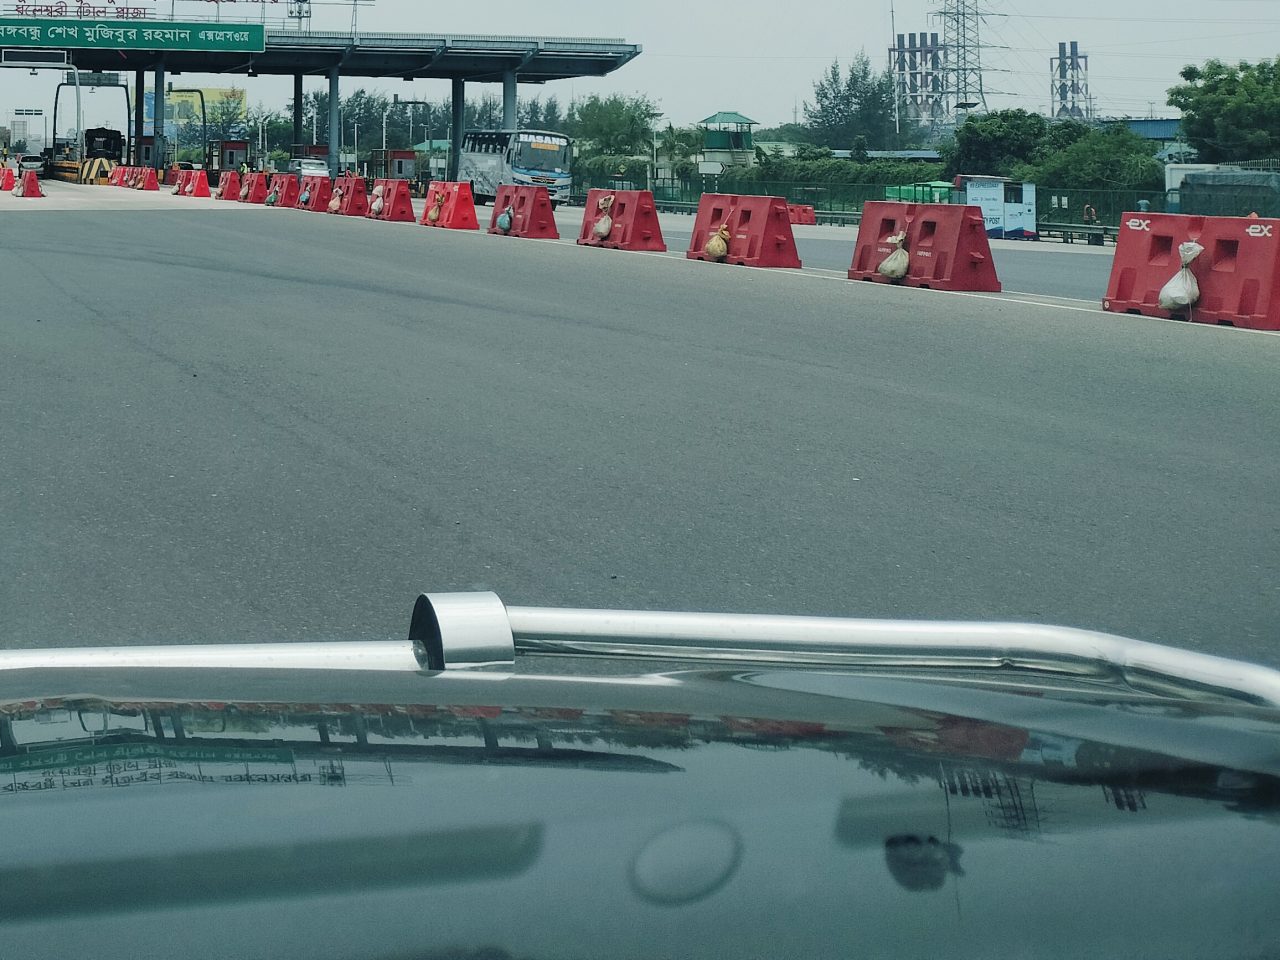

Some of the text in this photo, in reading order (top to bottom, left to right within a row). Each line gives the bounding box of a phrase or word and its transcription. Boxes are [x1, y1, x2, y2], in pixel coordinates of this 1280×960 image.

[48, 26, 78, 38] শেখ
[83, 24, 137, 43] মুজিবুর
[142, 28, 191, 42] রহমান
[520, 134, 567, 145] HASANS
